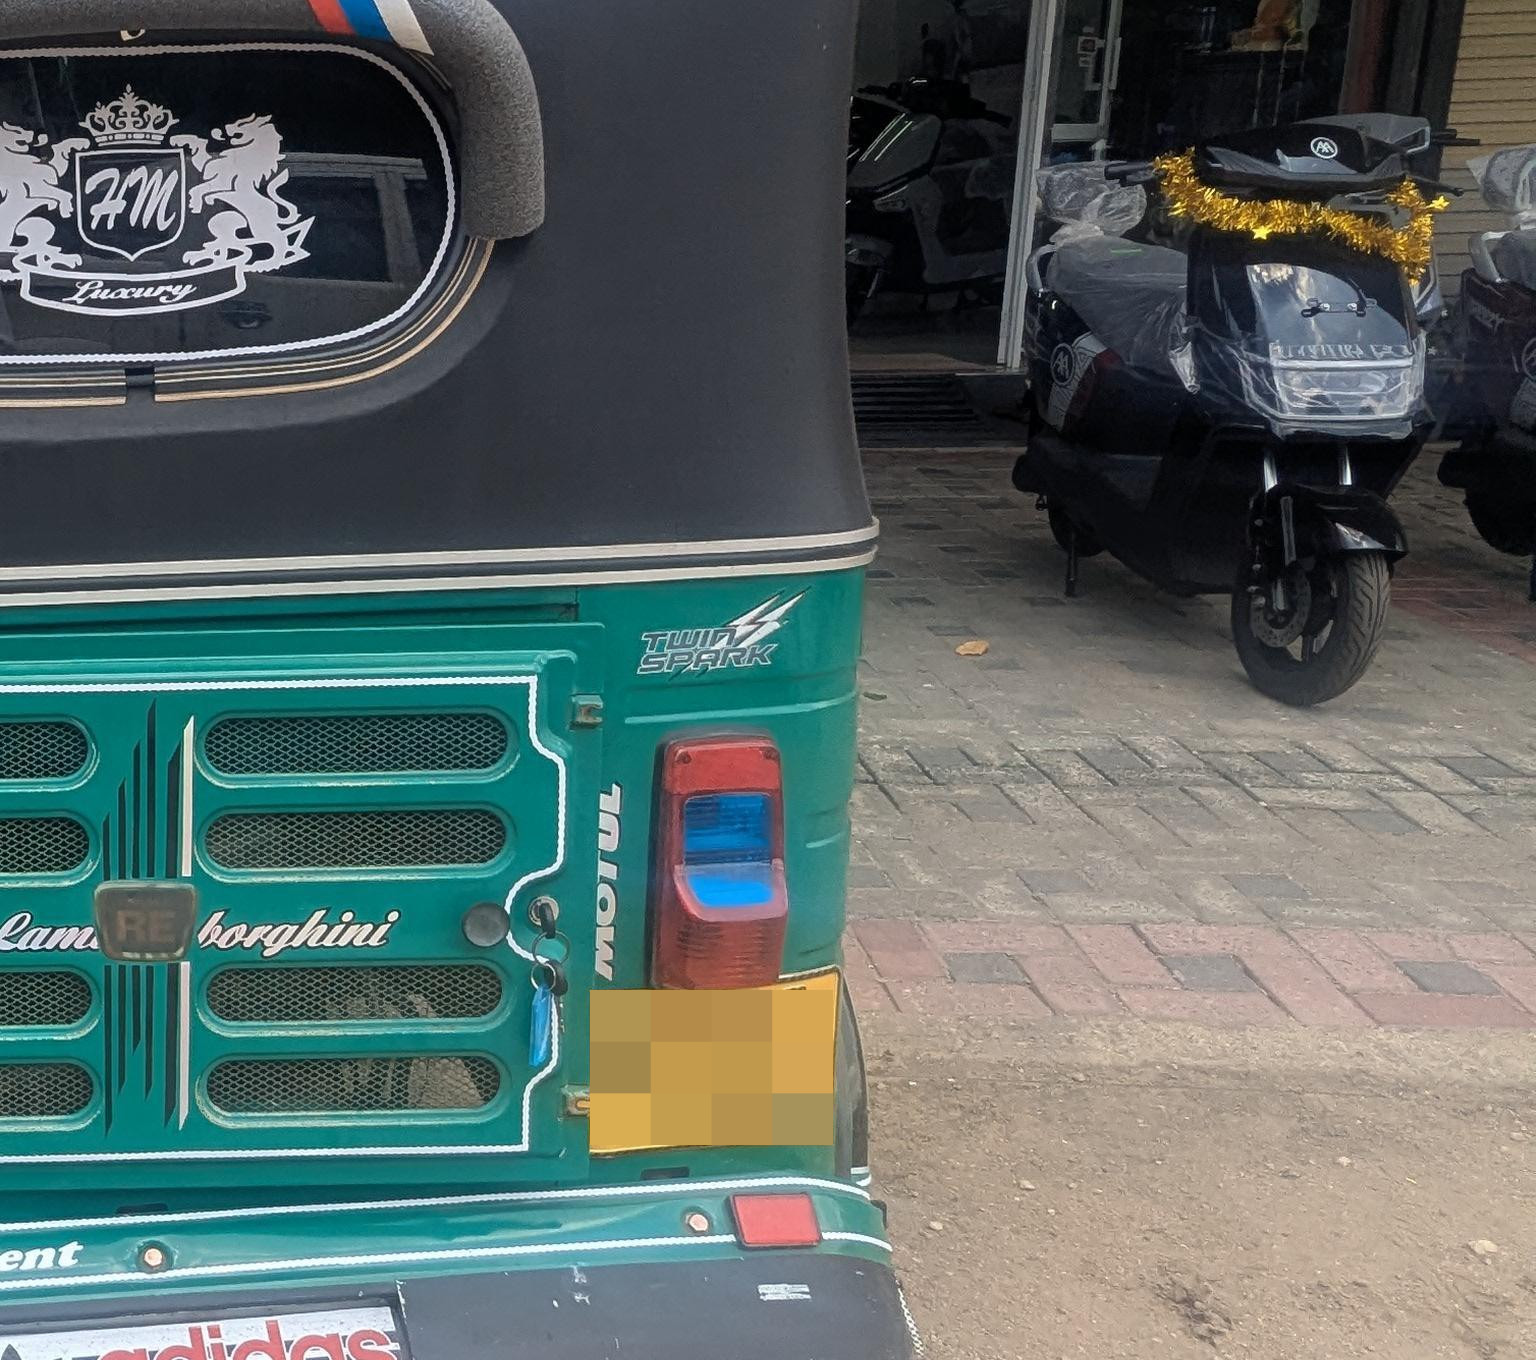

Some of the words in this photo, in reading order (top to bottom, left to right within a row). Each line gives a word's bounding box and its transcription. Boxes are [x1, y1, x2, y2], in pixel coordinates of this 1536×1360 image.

[62, 280, 197, 304] Luxury
[641, 626, 738, 653] TWIN
[636, 643, 779, 675] SPARK
[595, 783, 622, 982] MOTUL
[115, 910, 177, 944] RE
